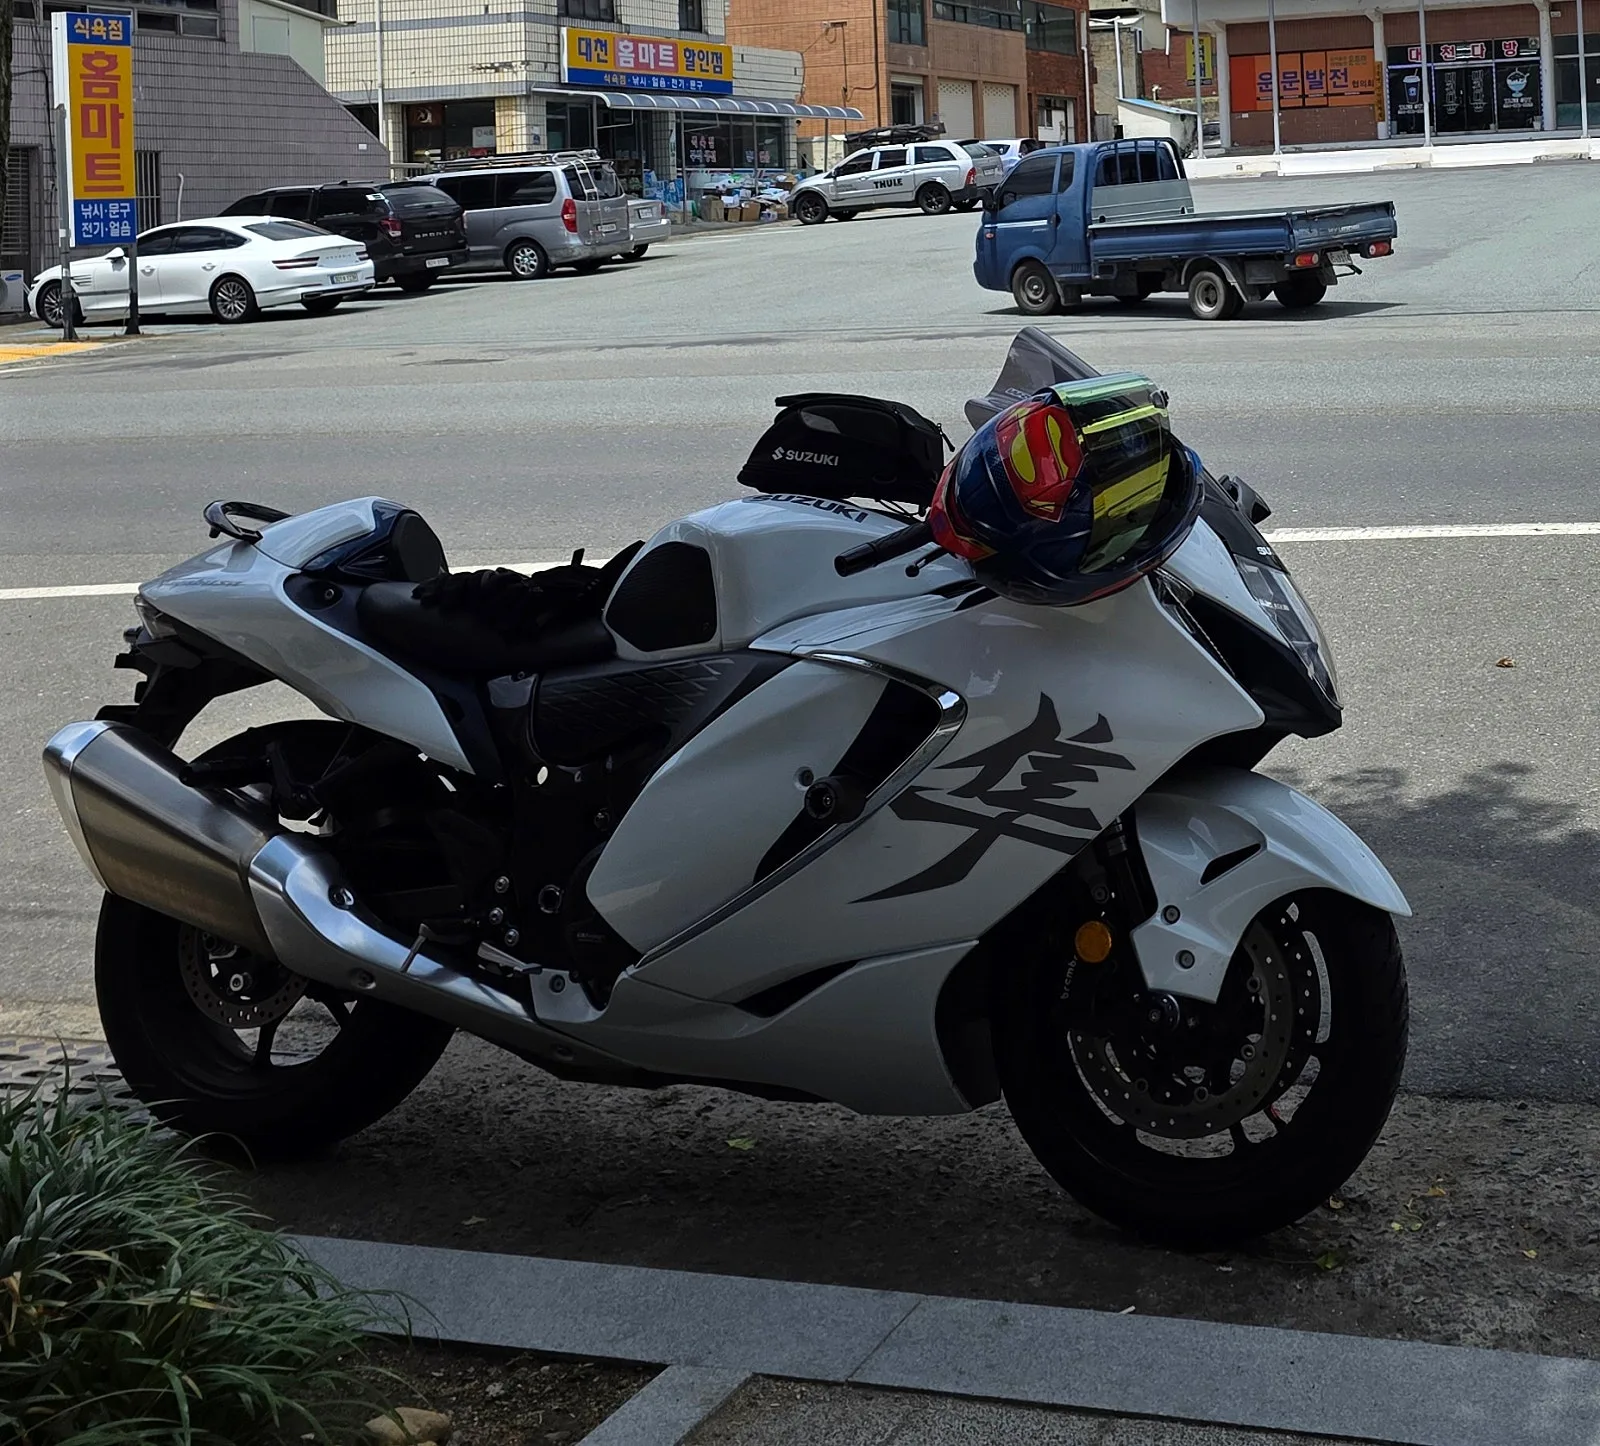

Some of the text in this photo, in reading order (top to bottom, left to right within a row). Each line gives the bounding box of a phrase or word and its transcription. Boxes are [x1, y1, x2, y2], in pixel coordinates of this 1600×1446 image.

[74, 18, 123, 40] 식육점
[578, 36, 724, 75] 대천 홈마트 할인점
[602, 73, 626, 85] 식육점
[632, 75, 647, 87] 낚시
[652, 76, 666, 88] 얼음
[671, 78, 685, 89] 전기
[1256, 67, 1349, 92] 운문발전
[80, 50, 125, 193] 홈마트
[873, 178, 903, 189] THULE
[785, 449, 840, 467] SUZUKI
[741, 494, 869, 523] SUZUKI
[847, 691, 1136, 904] 隼
